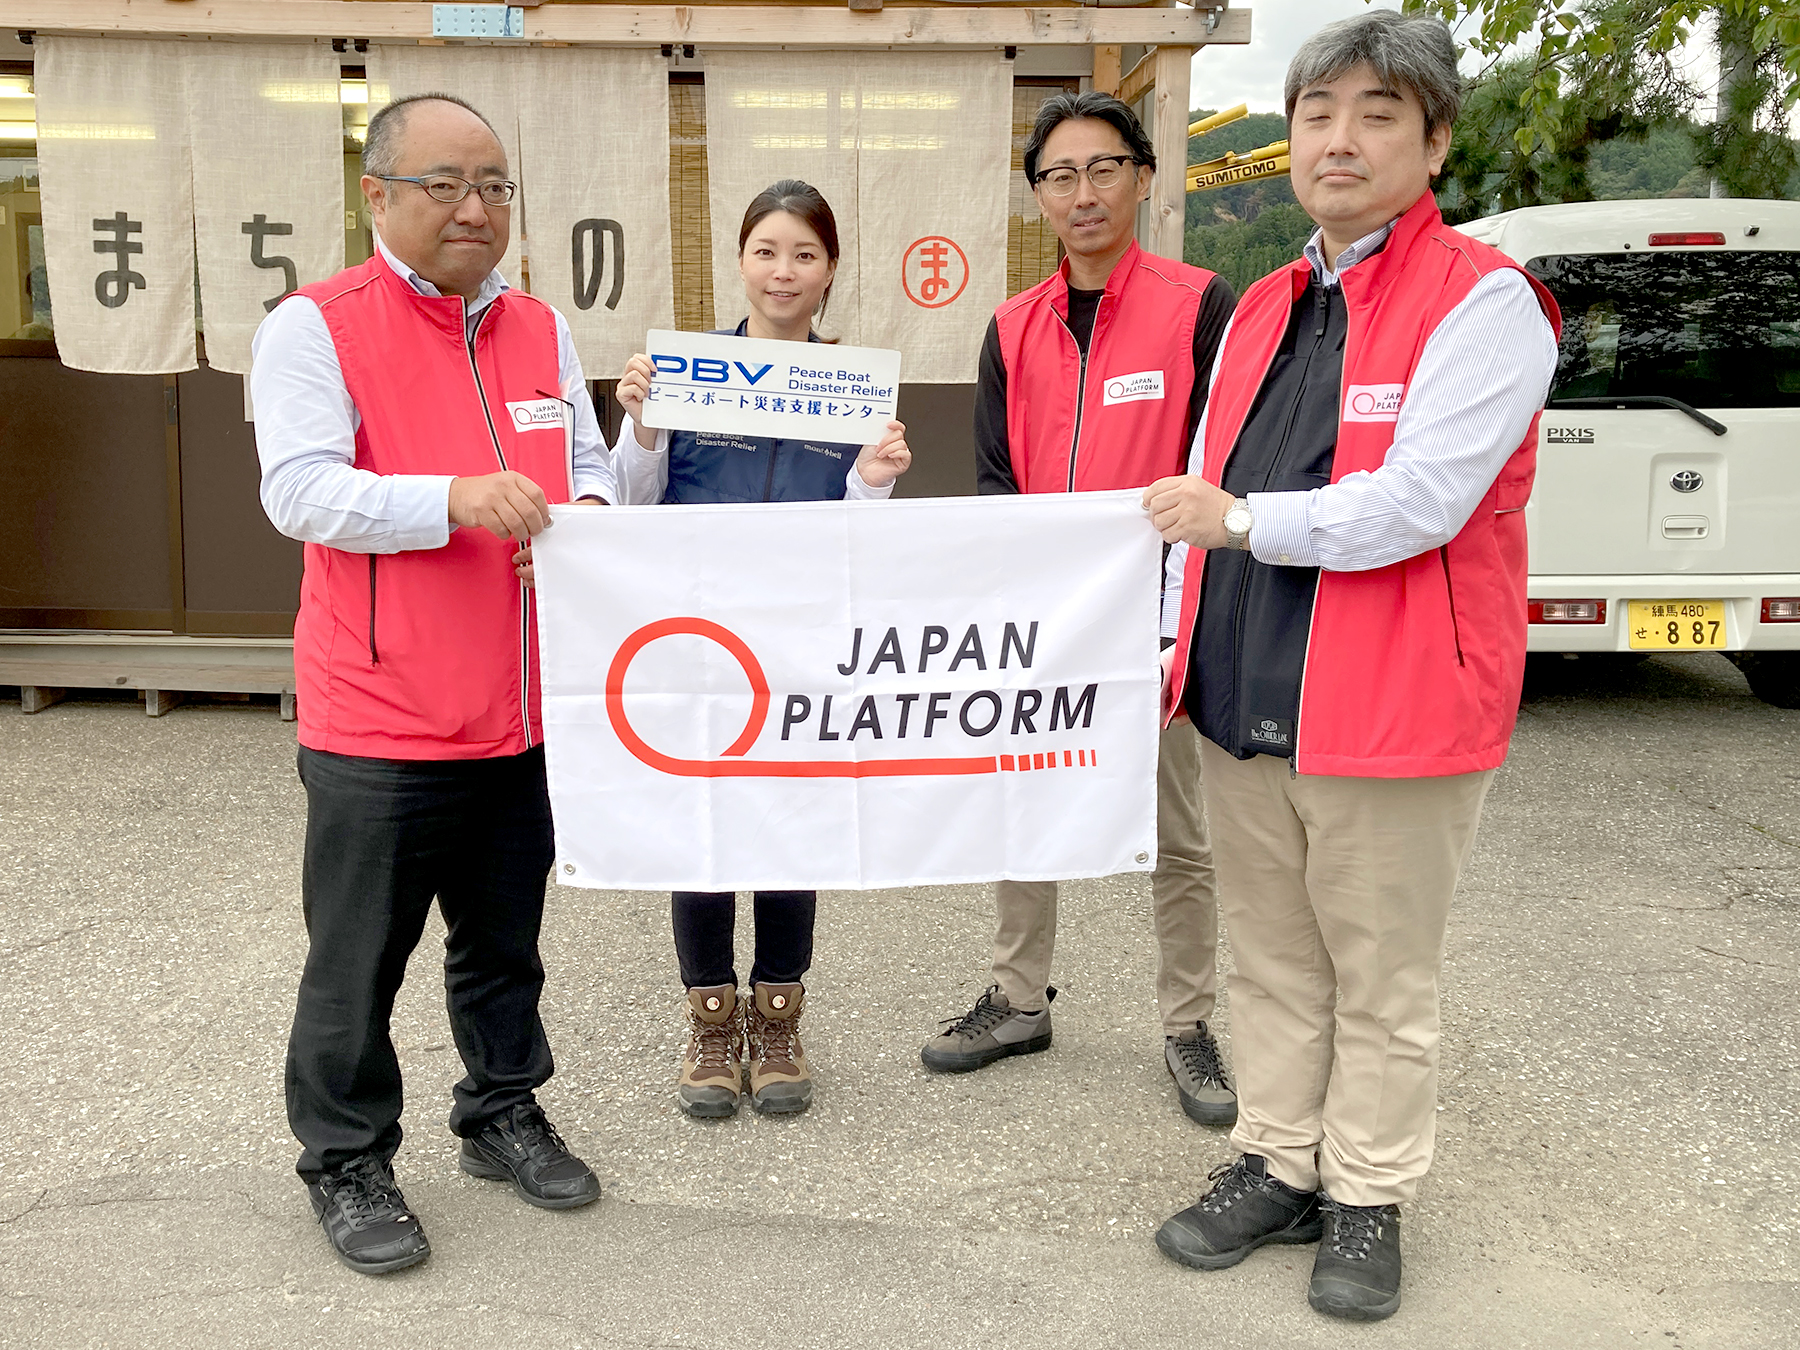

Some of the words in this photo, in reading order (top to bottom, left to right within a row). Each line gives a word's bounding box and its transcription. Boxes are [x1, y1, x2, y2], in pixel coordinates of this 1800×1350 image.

[1195, 160, 1276, 188] SUMITOMO
[651, 354, 774, 386] PBV
[789, 366, 833, 379] Peace
[837, 370, 871, 382] Boat
[788, 379, 848, 394] Disaster
[851, 384, 893, 398] Relief
[1126, 384, 1159, 393] PLATFORM
[1131, 377, 1152, 386] JAPAN
[535, 404, 557, 413] JAPAN
[648, 386, 891, 419] ピースボート災害支援センター
[696, 431, 721, 439] Peace
[1547, 427, 1595, 437] PIXIS
[696, 438, 729, 447] Disaster
[731, 441, 757, 452] Relief
[1681, 605, 1704, 617] 480
[836, 620, 1039, 676] JAPAN
[780, 683, 1098, 741] PLATFORM
